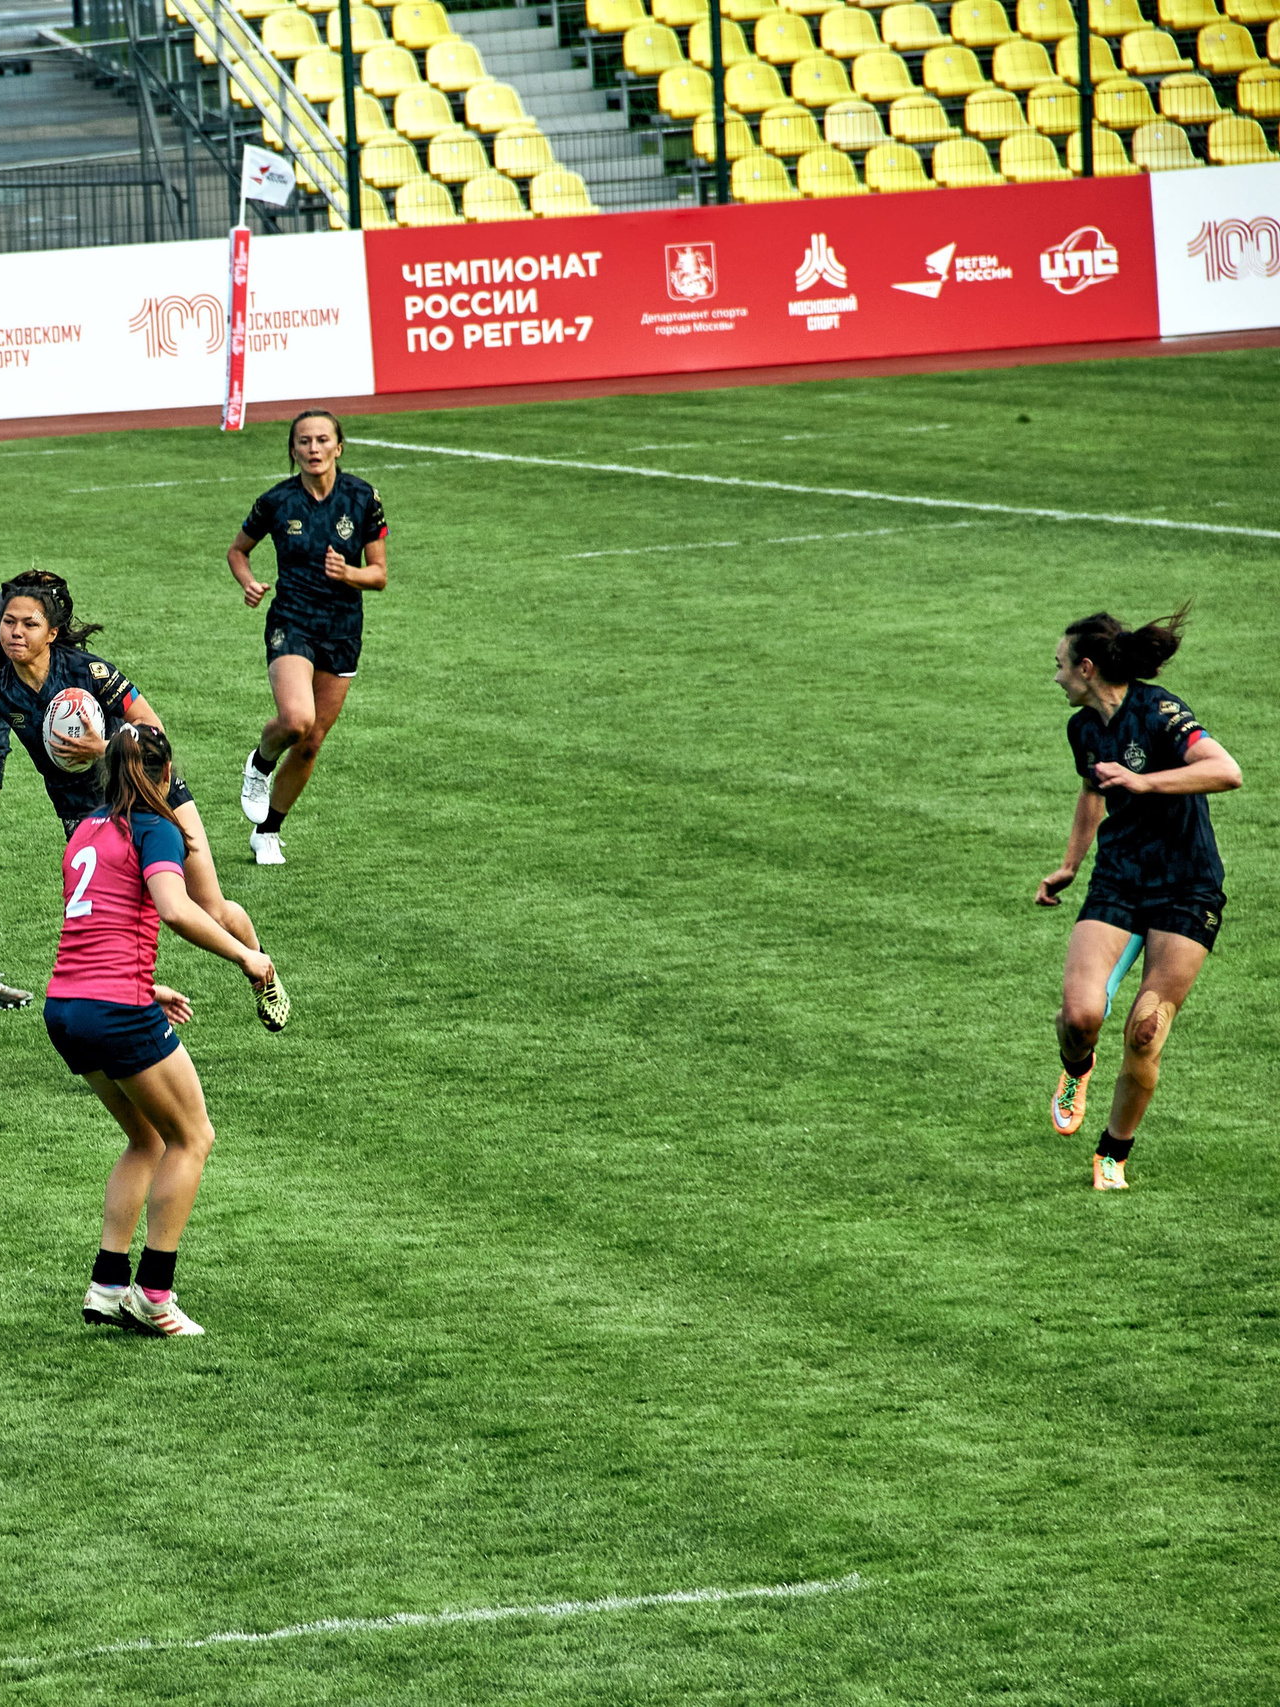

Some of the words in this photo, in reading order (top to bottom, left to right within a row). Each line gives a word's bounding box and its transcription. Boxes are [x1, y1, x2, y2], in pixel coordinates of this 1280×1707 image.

[401, 251, 603, 288] ЧЕМПИОНАТ
[955, 254, 999, 269] РЕГБИ
[1040, 248, 1119, 280] ЦПС
[956, 267, 1013, 282] РОССИИ
[404, 288, 539, 321] РОССИИ
[641, 309, 709, 325] Департамент
[711, 307, 748, 320] спорта
[788, 293, 859, 316] МОСКОВСКИЙ
[406, 325, 454, 353] ПО
[463, 315, 594, 350] РЕГБИ-7
[655, 323, 692, 336] города
[693, 321, 735, 333] Москвы
[806, 314, 841, 331] СПОРТ
[66, 846, 97, 919] 2
